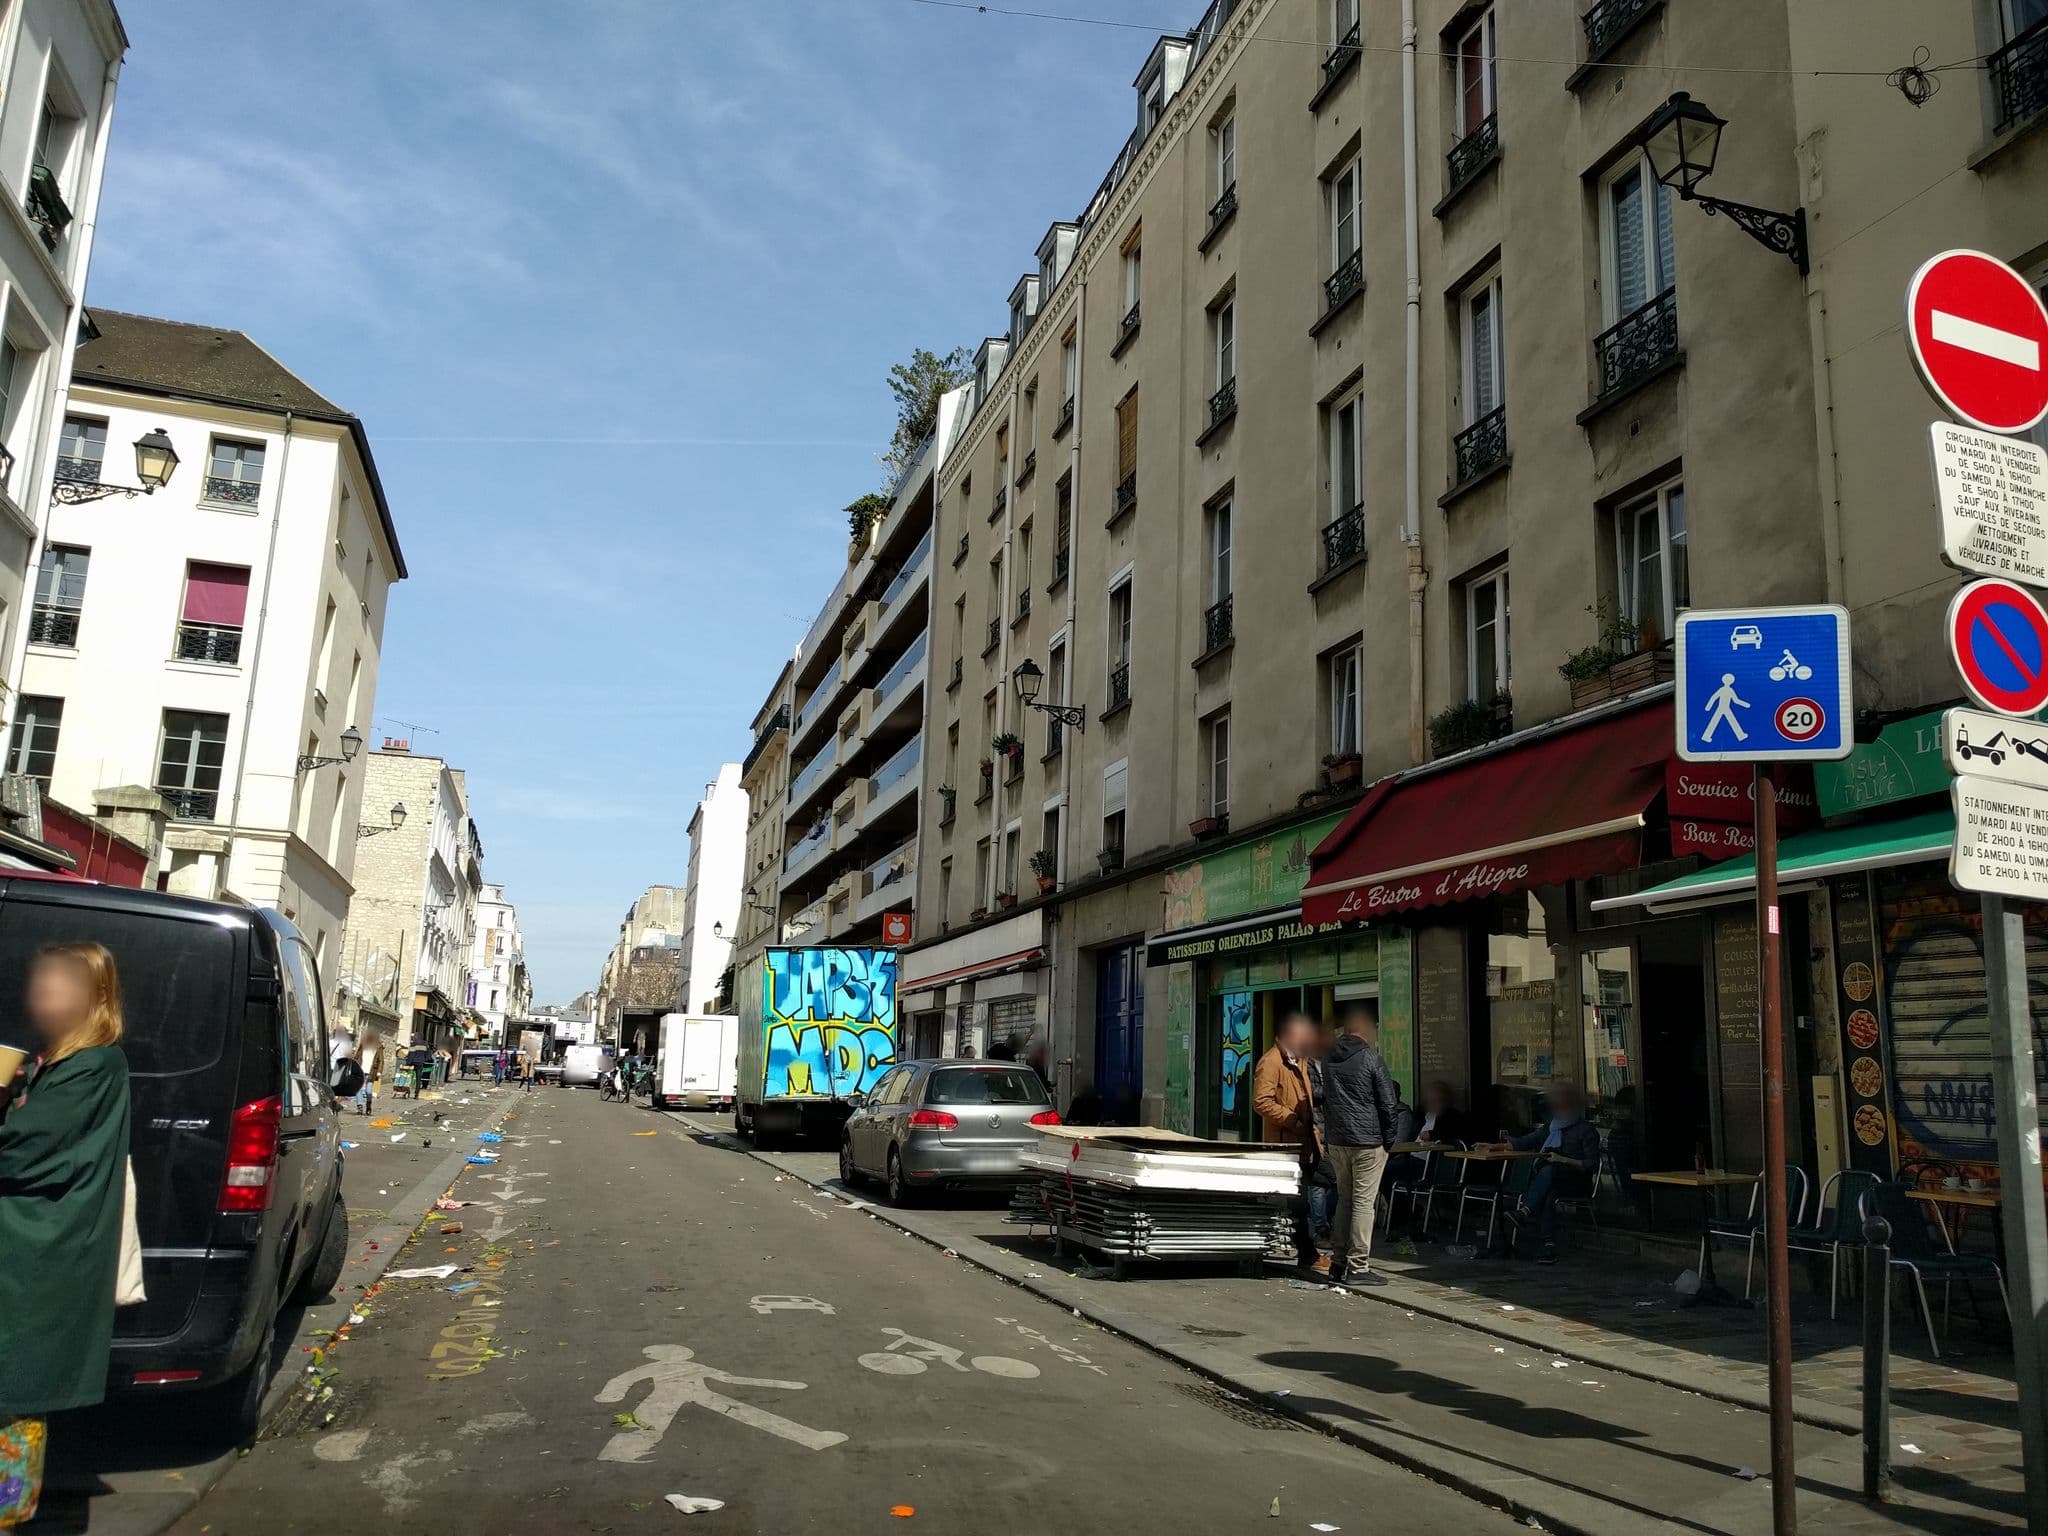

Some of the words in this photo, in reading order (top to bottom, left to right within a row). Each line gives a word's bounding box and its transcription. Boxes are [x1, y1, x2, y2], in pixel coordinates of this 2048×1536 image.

[1945, 443, 1956, 453] DU
[1960, 447, 1986, 460] MARDI
[1991, 454, 2001, 464] AU
[2005, 458, 2040, 475] VENDREDI
[1946, 431, 1997, 451] CIRCULATION
[2000, 444, 2037, 462] INTERDITE
[1945, 467, 1956, 477] DU
[1961, 471, 1991, 486] SAMEDI
[1996, 479, 2005, 489] AU
[2010, 483, 2046, 500] DIMANCHE
[1958, 458, 1968, 468] DE
[2009, 471, 2032, 484] 16H00
[1962, 483, 1973, 493] DE
[2012, 496, 2034, 510] 17H00
[1954, 506, 1997, 524] VÉHICULES
[2001, 518, 2010, 529] DE
[2014, 522, 2046, 539] SECOURS
[1957, 495, 1980, 507] SAUF
[1985, 500, 2000, 513] AUX
[2004, 506, 2041, 525] RIVERAINS
[1978, 524, 2027, 546] NETTOIEMENT
[1973, 537, 2018, 558] LIVRAISONS
[2021, 550, 2030, 561] ET
[1959, 546, 1997, 566] VÉHICULES
[2000, 558, 2011, 570] DE
[2014, 561, 2046, 578] MARCHÉ
[1786, 711, 1813, 727] 20
[1677, 776, 1739, 799] Service
[1964, 797, 2031, 817] STATIONNEMENT
[1683, 822, 1718, 844] Bar
[1968, 813, 1979, 825] DU
[1981, 816, 2007, 830] MARDI
[2010, 821, 2022, 832] AU
[2025, 824, 2048, 837] VEND
[1977, 832, 1989, 843] DE
[1991, 835, 2015, 847] 2H00
[2019, 836, 2024, 849] À
[1963, 846, 1973, 857] DU
[1976, 848, 2012, 862] SAMEDI
[2014, 854, 2026, 865] AU
[1979, 864, 1992, 876] DE
[1995, 867, 2020, 879] 2H00
[2023, 869, 2029, 881] À
[1337, 893, 1363, 914] Le
[1369, 885, 1421, 908] Bistro
[1436, 862, 1529, 895] d'Aligre
[1168, 939, 1215, 960] PATISSERIES
[1219, 928, 1273, 951] ORIENTALES
[1277, 922, 1314, 940] PALAIS
